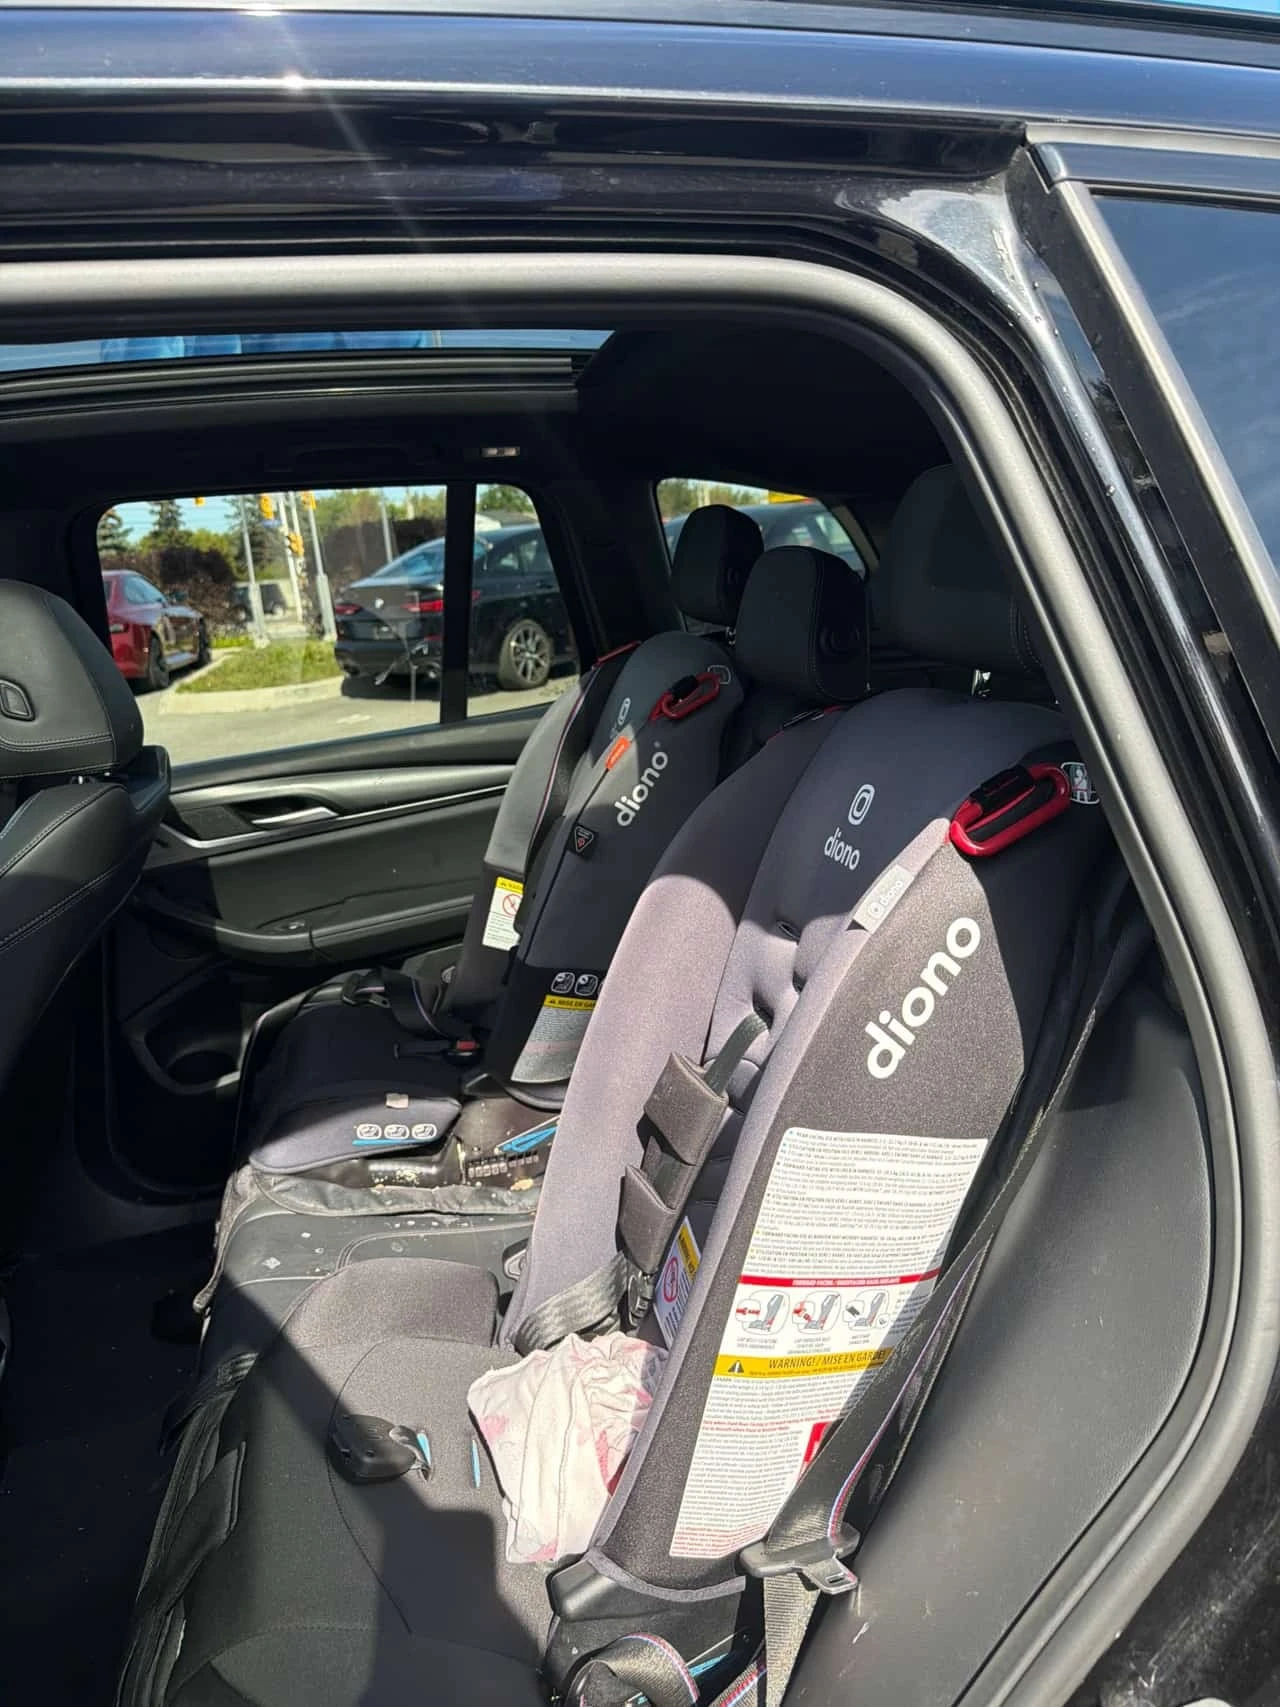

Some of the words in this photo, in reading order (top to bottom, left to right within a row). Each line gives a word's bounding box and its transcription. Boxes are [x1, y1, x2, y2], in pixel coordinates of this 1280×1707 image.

[614, 751, 669, 827] diono
[824, 827, 860, 870] diono
[865, 917, 981, 1079] diono
[769, 1357, 816, 1370] WARNING!
